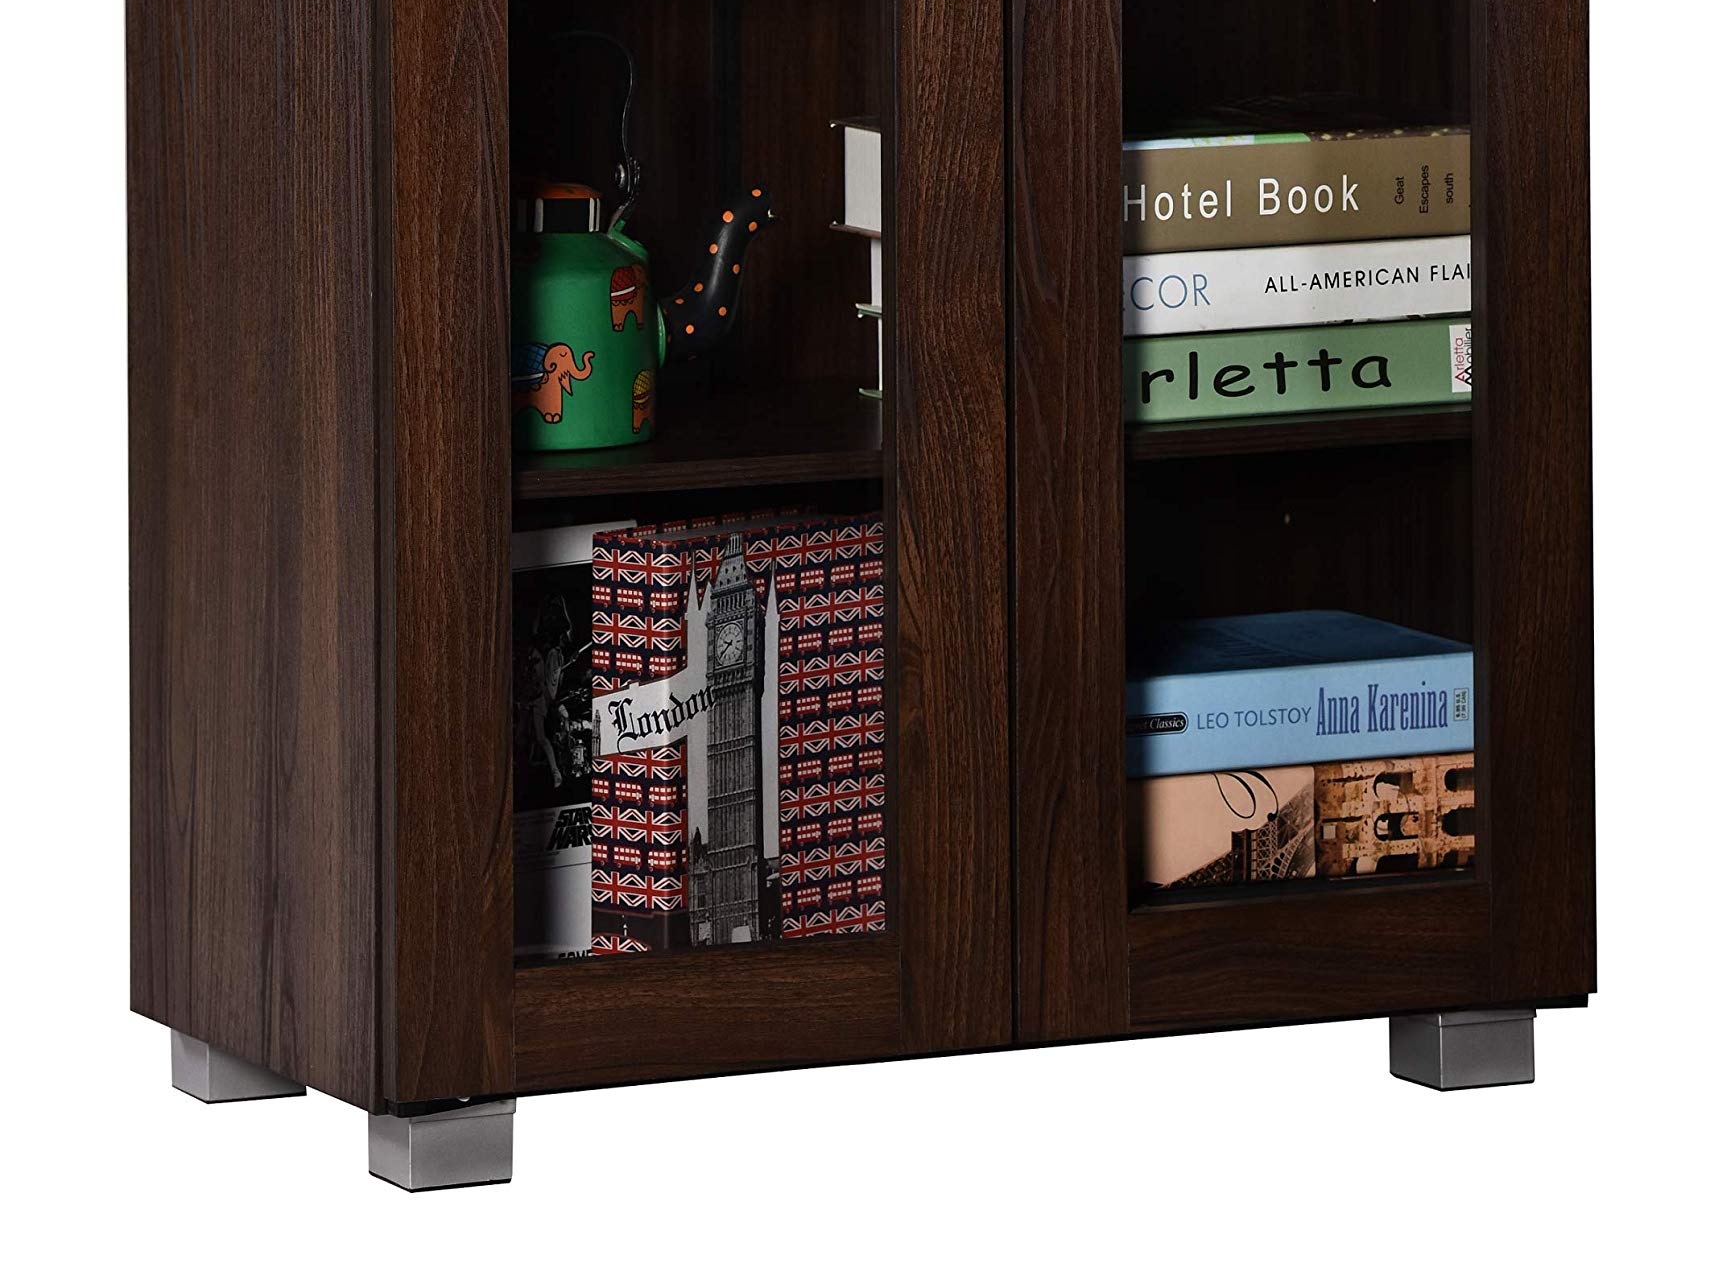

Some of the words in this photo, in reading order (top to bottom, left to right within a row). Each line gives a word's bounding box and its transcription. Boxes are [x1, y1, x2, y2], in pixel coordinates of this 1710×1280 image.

[1124, 179, 1232, 221] Hotel
[1258, 174, 1360, 216] Book
[1419, 165, 1431, 214] Escapes
[1444, 172, 1454, 204] south
[1123, 273, 1211, 311] COR
[1264, 266, 1420, 294] ALL-AMERICAN
[1141, 348, 1392, 405] rletta
[1454, 337, 1465, 382] Arletta
[608, 685, 716, 755] London
[1149, 717, 1185, 730] Classics
[1197, 712, 1229, 730] LEO
[1233, 706, 1312, 728] TOLSTOY
[1316, 687, 1360, 736] Anna
[1367, 680, 1448, 733] Karenina
